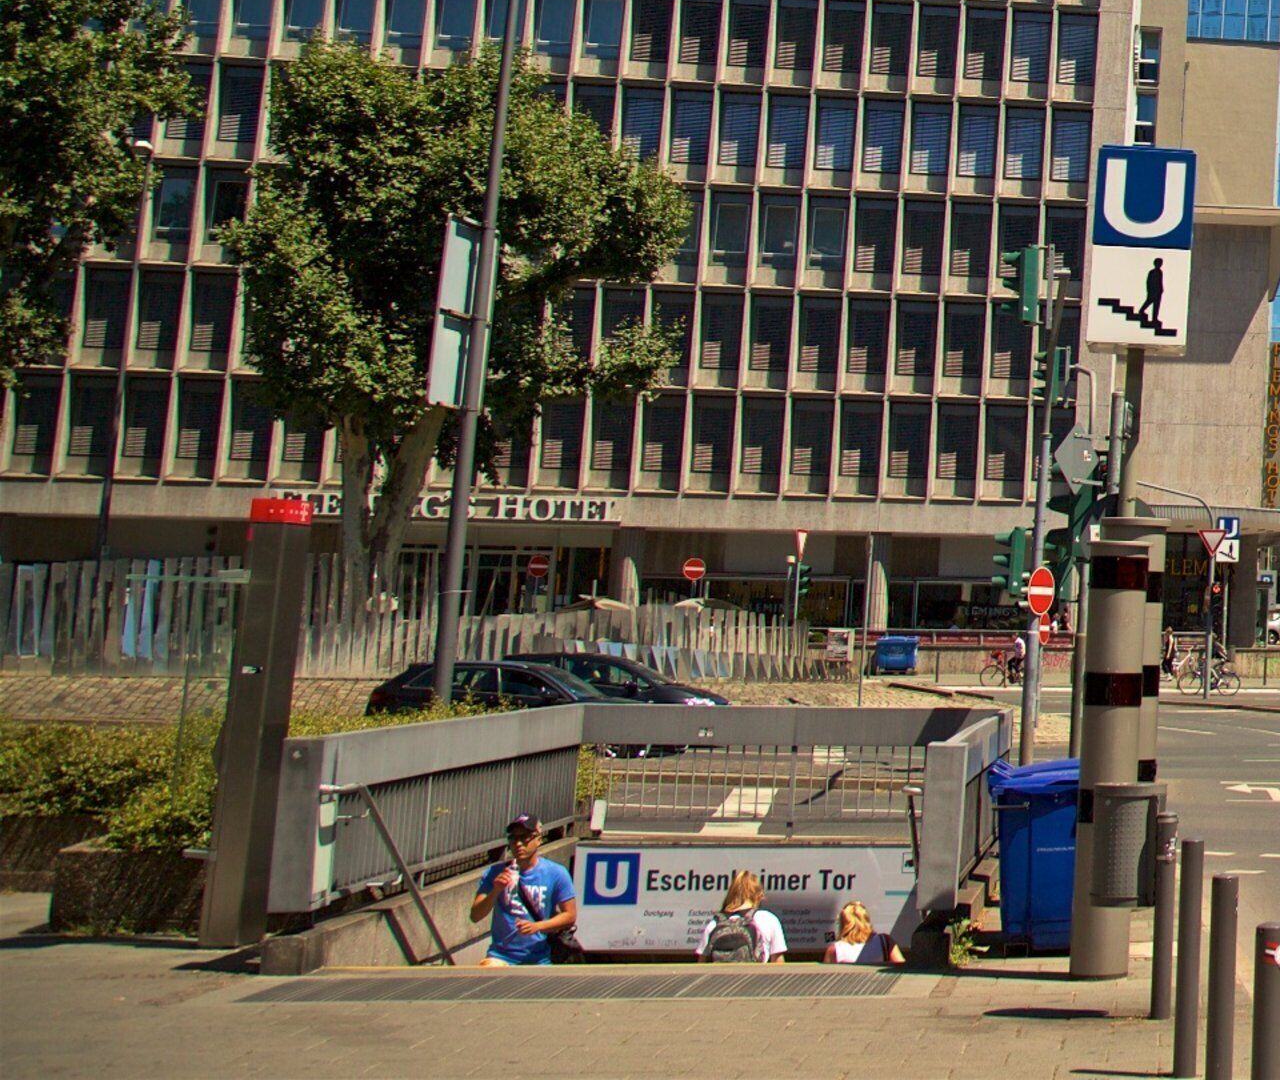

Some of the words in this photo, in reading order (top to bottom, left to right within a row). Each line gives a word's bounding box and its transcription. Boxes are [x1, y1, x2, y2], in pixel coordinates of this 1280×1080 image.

[1104, 158, 1187, 238] U
[498, 495, 623, 522] HOTEL
[594, 861, 630, 897] U
[646, 868, 810, 891] Eschenimer
[820, 869, 856, 890] Tor
